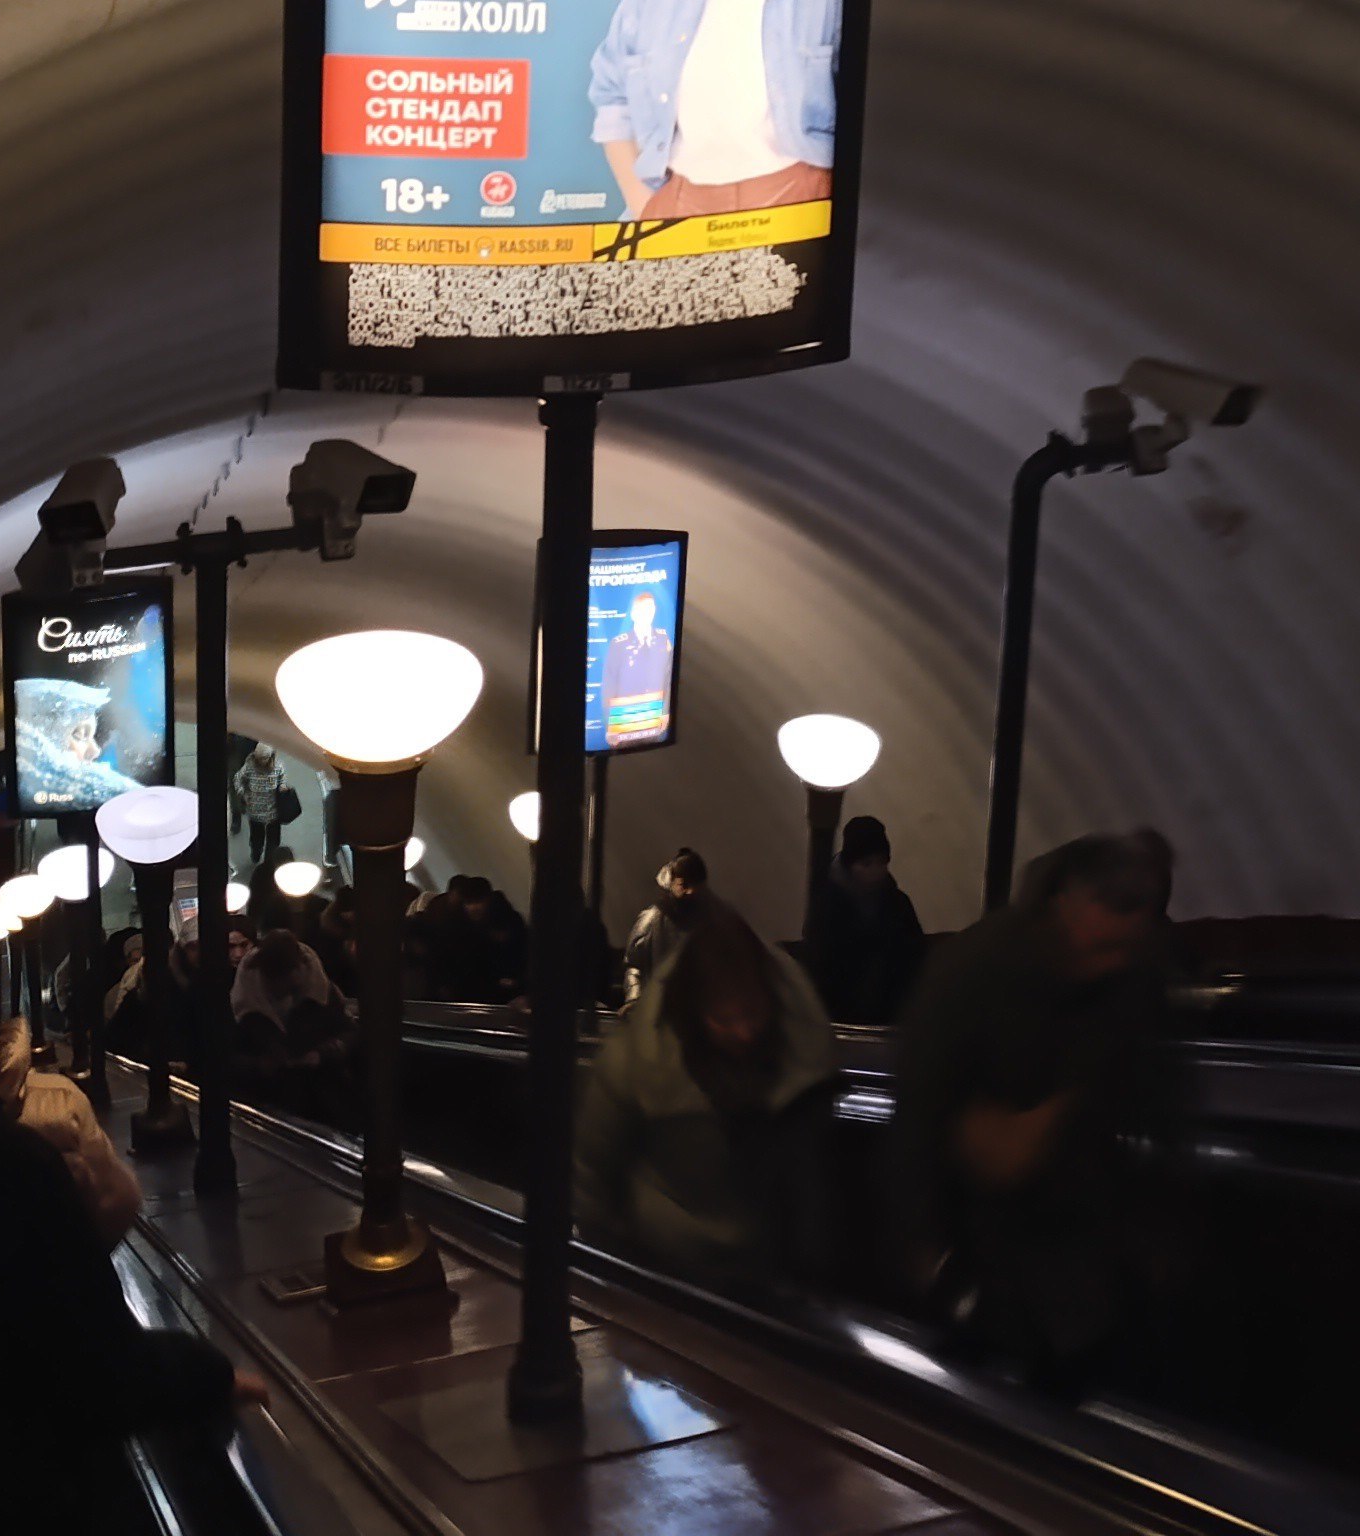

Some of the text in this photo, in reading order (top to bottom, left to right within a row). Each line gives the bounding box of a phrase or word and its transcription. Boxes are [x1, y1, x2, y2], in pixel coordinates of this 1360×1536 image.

[461, 1, 547, 34] ХОЛЛ
[365, 68, 514, 95] СОЛЬНЫЙ
[365, 99, 503, 125] СТЕНДАП
[365, 125, 498, 151] КОНЦЕРТ
[380, 178, 451, 214] 18+
[374, 237, 471, 254] ВСЕ БИЛЕТЫ
